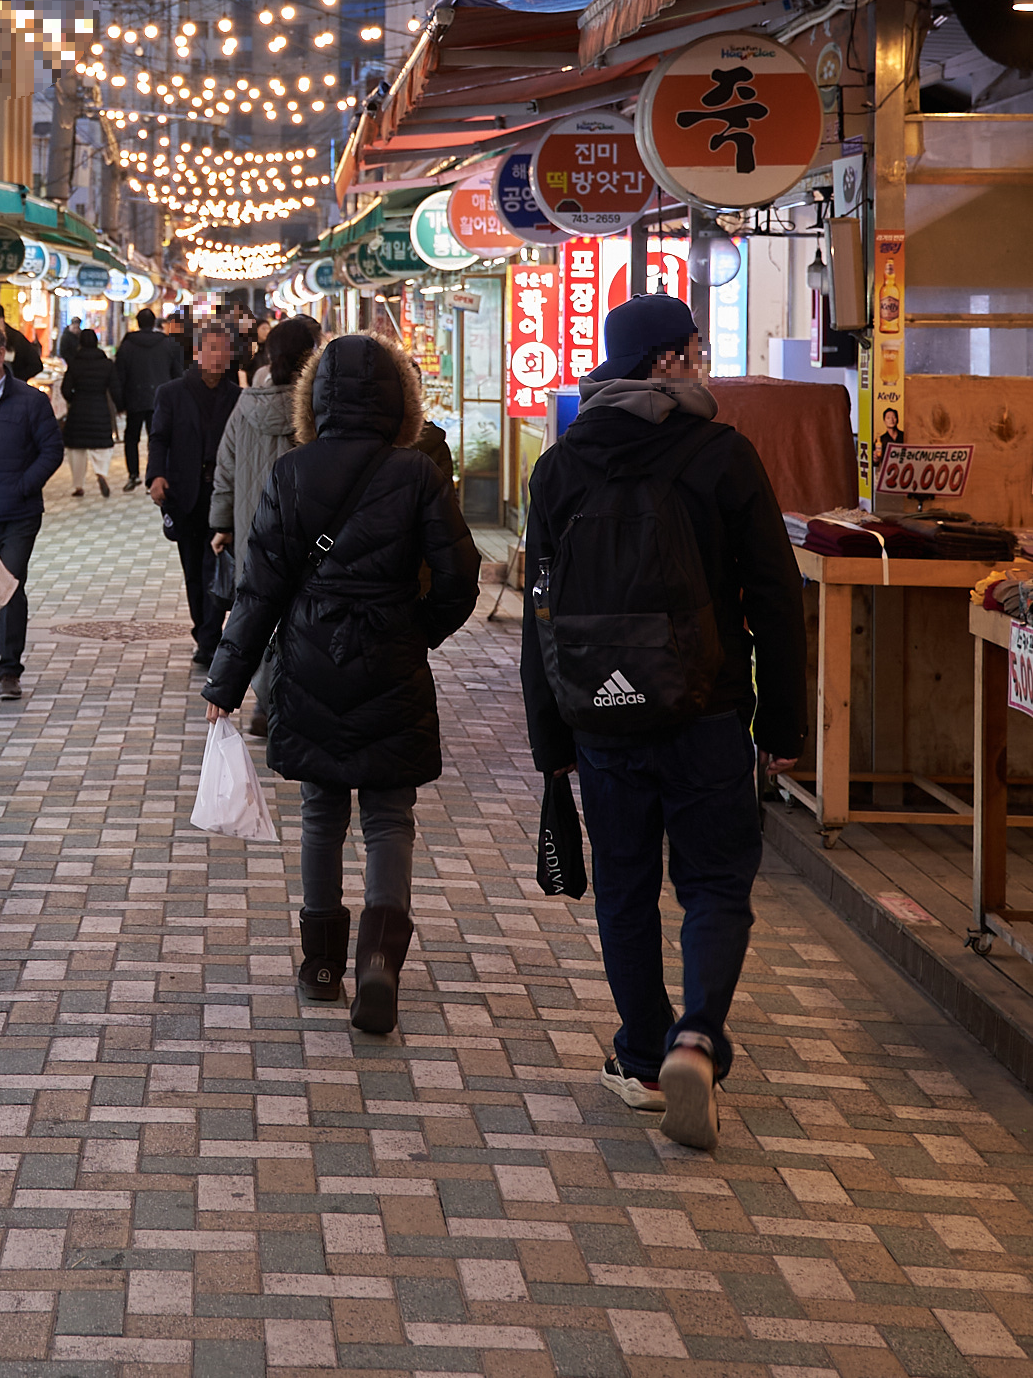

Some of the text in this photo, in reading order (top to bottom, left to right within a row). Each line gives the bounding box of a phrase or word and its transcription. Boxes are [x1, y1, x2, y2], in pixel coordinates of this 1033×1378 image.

[676, 66, 769, 174] 죽
[575, 143, 617, 164] 진미
[571, 214, 621, 224] 743-2659
[453, 294, 474, 305] OPEN
[569, 250, 596, 378] 포장전문
[880, 302, 899, 313] Kelly
[877, 391, 901, 403] Kelly
[886, 463, 965, 493] 20,000
[593, 692, 646, 707] adidas
